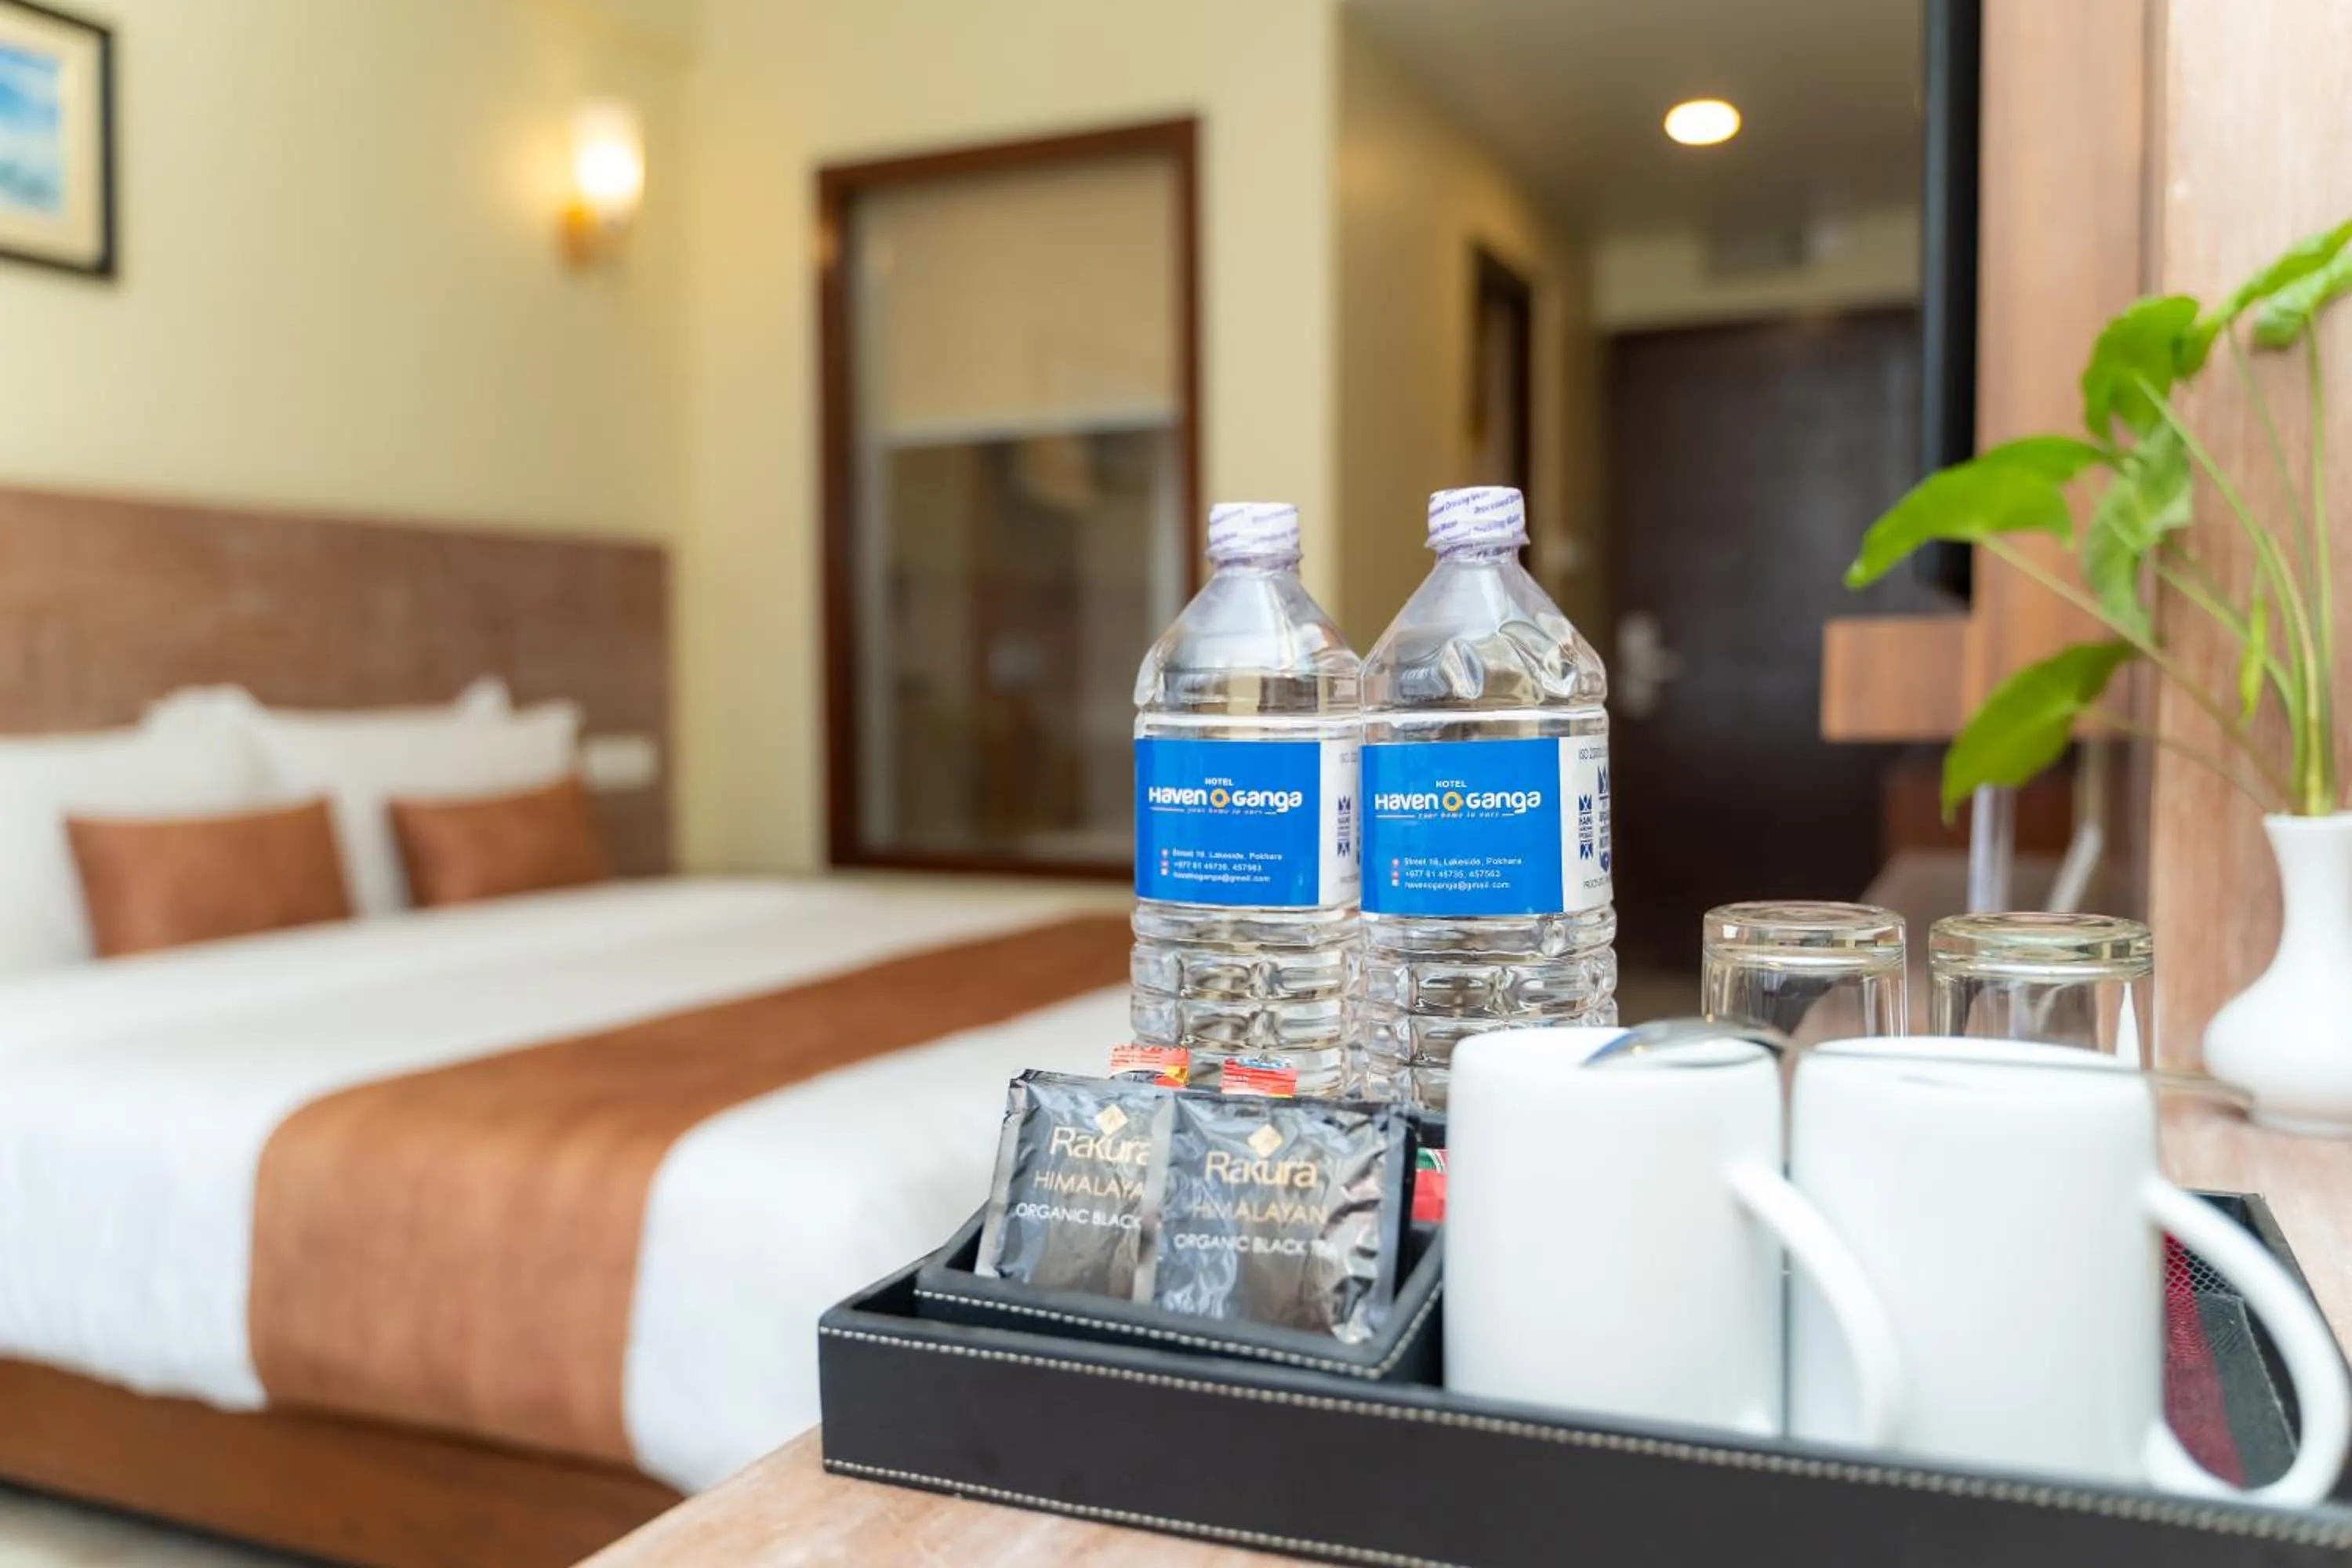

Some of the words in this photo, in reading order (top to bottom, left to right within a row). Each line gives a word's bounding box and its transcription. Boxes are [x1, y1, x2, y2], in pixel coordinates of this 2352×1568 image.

[1205, 778, 1234, 786] HOTEL
[1149, 786, 1207, 805] Haven
[1232, 789, 1303, 813] Ganga
[1374, 793, 1439, 811] Haven
[1466, 790, 1541, 815] Ganga
[1249, 852, 1283, 861] Pokhara
[1404, 857, 1426, 866] Street
[1486, 856, 1522, 866] Pokhara
[1204, 1150, 1318, 1189] Rakura
[1033, 1170, 1144, 1200] HIMALAYA
[1015, 1203, 1090, 1224] ORGANIC
[1192, 1198, 1329, 1225] HIMALAYAN
[1174, 1233, 1250, 1253] ORGANIC
[1252, 1236, 1307, 1254] BLACK
